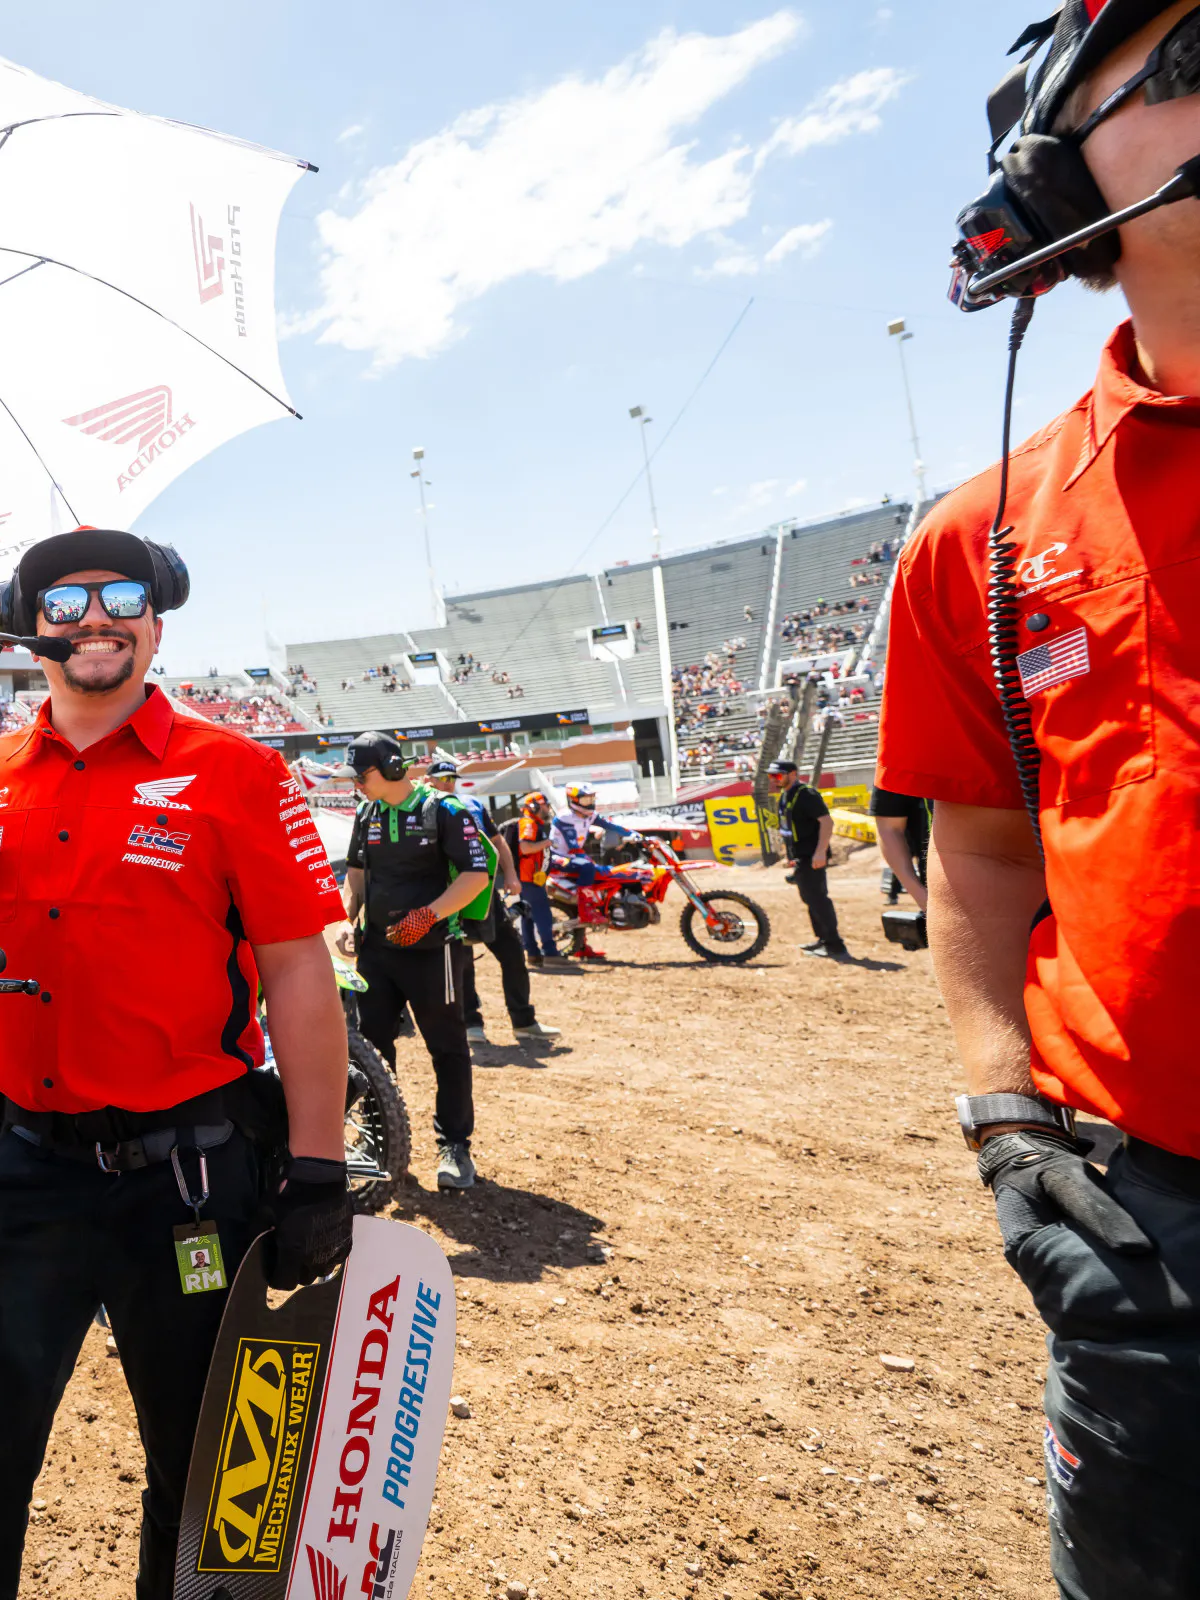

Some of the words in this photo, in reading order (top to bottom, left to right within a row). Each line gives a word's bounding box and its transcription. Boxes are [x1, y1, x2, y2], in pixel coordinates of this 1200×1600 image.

[132, 797, 192, 811] HONDA
[127, 824, 192, 852] HRC
[292, 818, 313, 830] DUN
[122, 853, 182, 872] PROGRESSIVE
[185, 1269, 223, 1292] RM
[326, 1274, 401, 1543] HONDA
[382, 1281, 441, 1510] PROGRESSIVE
[254, 1430, 300, 1564] MECHANIX
[289, 1351, 314, 1430] WEAR
[390, 1529, 404, 1578] RACING
